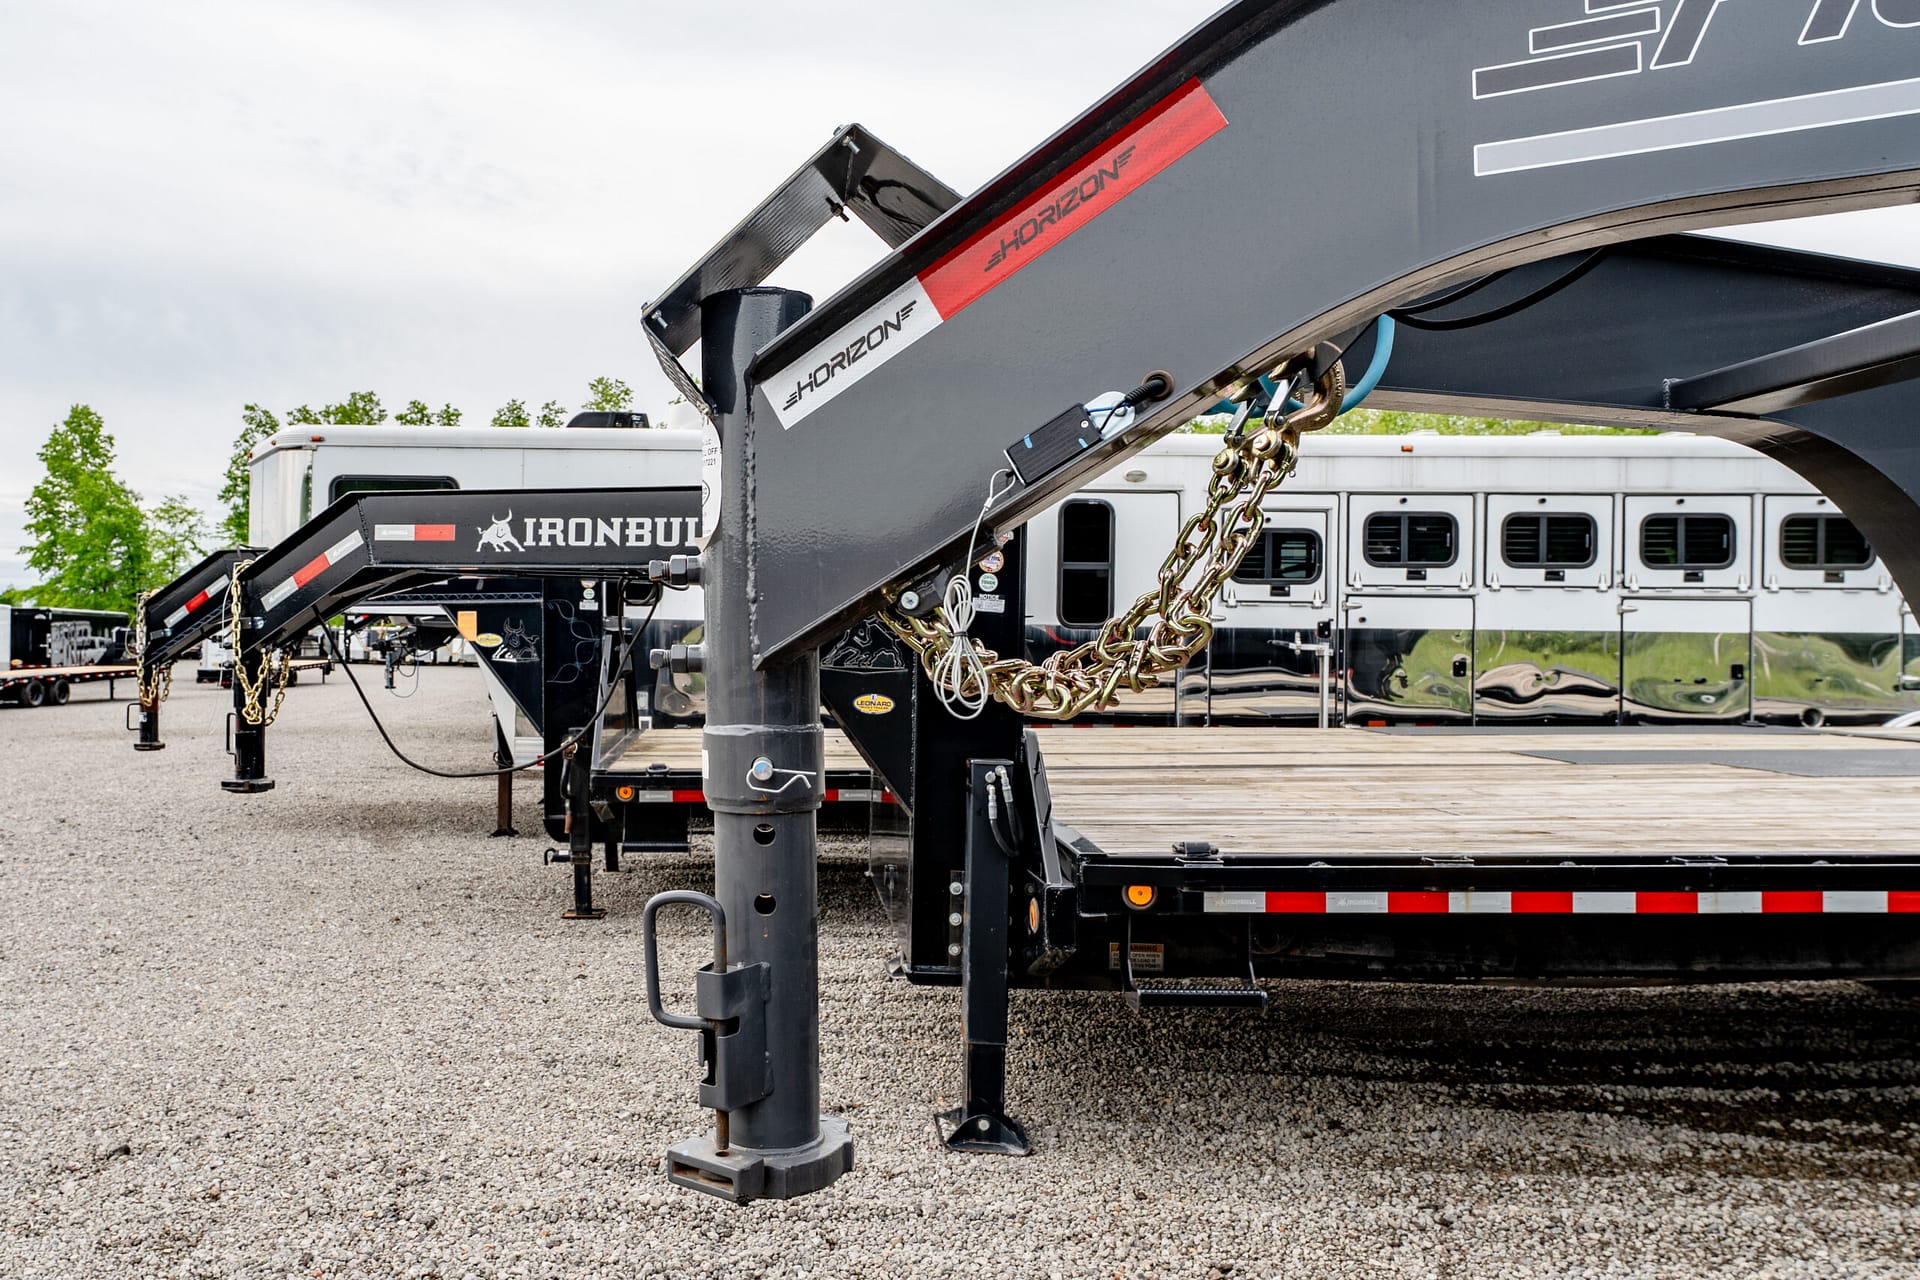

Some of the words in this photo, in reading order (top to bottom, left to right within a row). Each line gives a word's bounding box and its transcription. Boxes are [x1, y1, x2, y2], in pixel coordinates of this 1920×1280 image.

[998, 157, 1120, 262] HORIZON
[795, 310, 903, 402] HORIZON
[1129, 944, 1158, 952] ARNING
